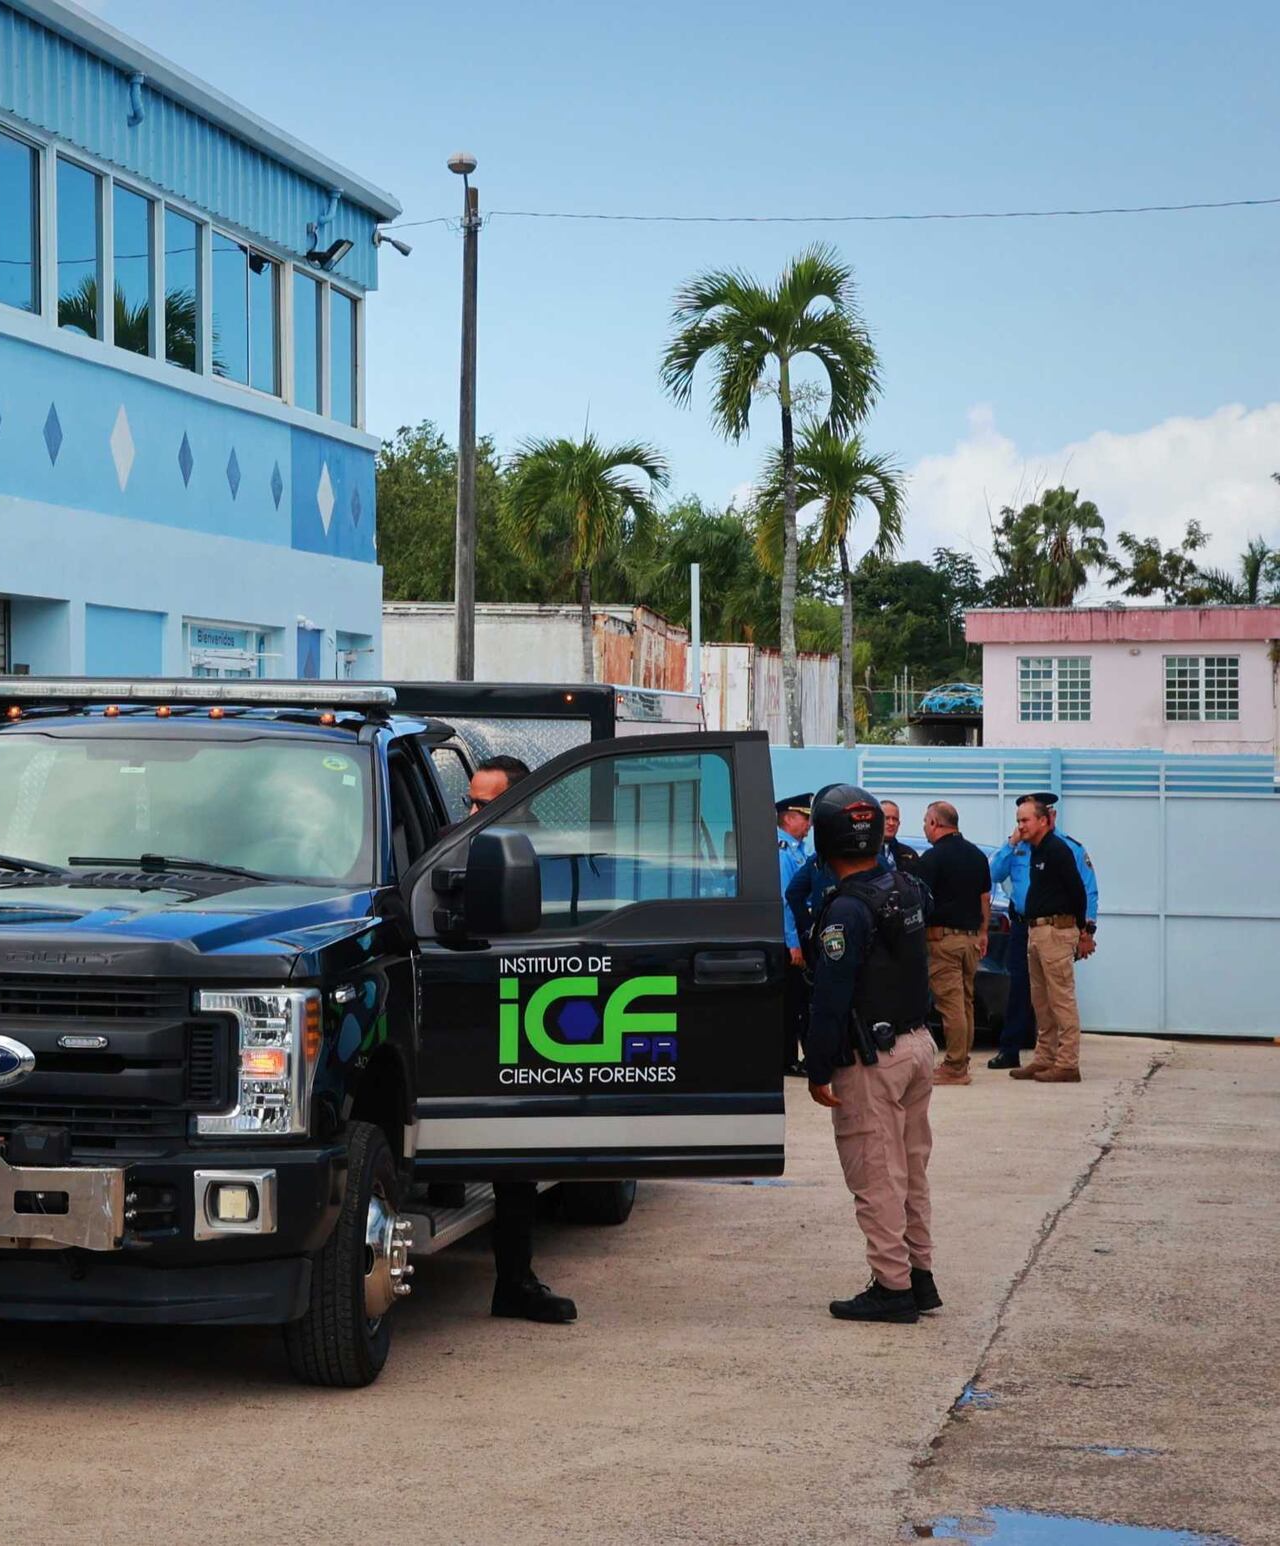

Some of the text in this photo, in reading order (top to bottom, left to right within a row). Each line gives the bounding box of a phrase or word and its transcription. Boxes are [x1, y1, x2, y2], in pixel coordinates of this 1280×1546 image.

[197, 629, 235, 647] Bienvenidos
[499, 956, 612, 973] INSTITUTO DE
[499, 1066, 677, 1084] CIENCIAS FORENSES
